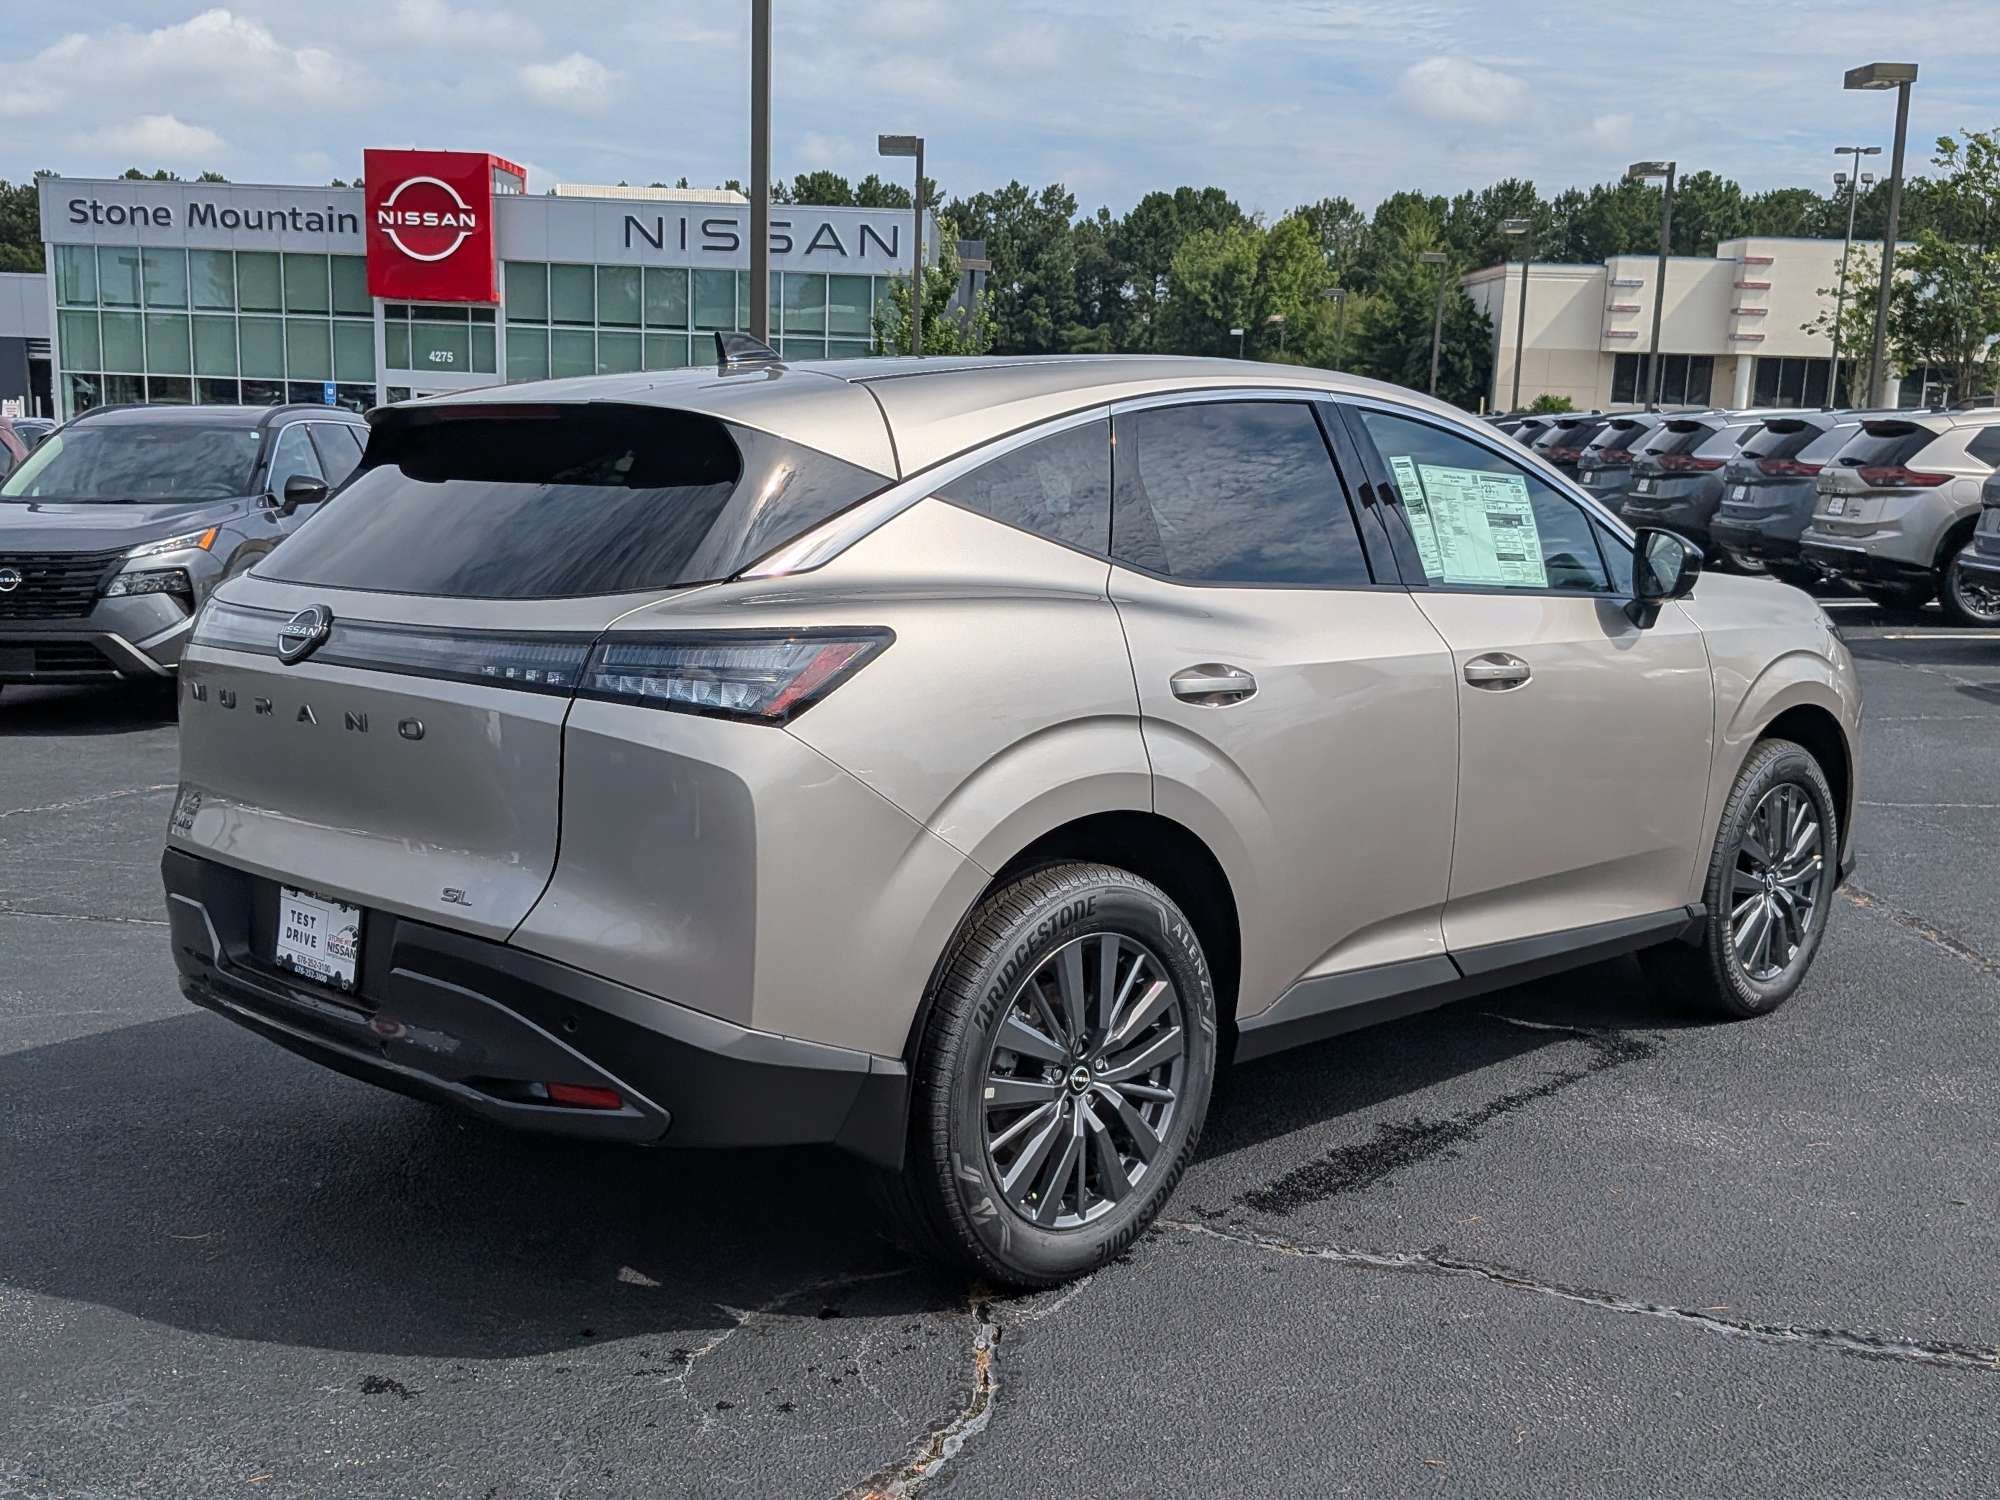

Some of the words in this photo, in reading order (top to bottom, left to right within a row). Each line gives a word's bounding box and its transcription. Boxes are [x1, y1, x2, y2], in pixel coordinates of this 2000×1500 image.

[68, 198, 172, 227] Stone
[188, 202, 358, 234] Mountain
[377, 209, 476, 228] NISSAN
[624, 214, 899, 259] NISSAN
[428, 350, 454, 363] 4275
[440, 887, 473, 907] SL
[290, 909, 317, 929] TEST
[286, 926, 318, 948] DRIVE
[326, 941, 357, 960] NISSAN
[973, 894, 1097, 1036] BRIDGESTONE
[1172, 922, 1212, 1012] ALENZA
